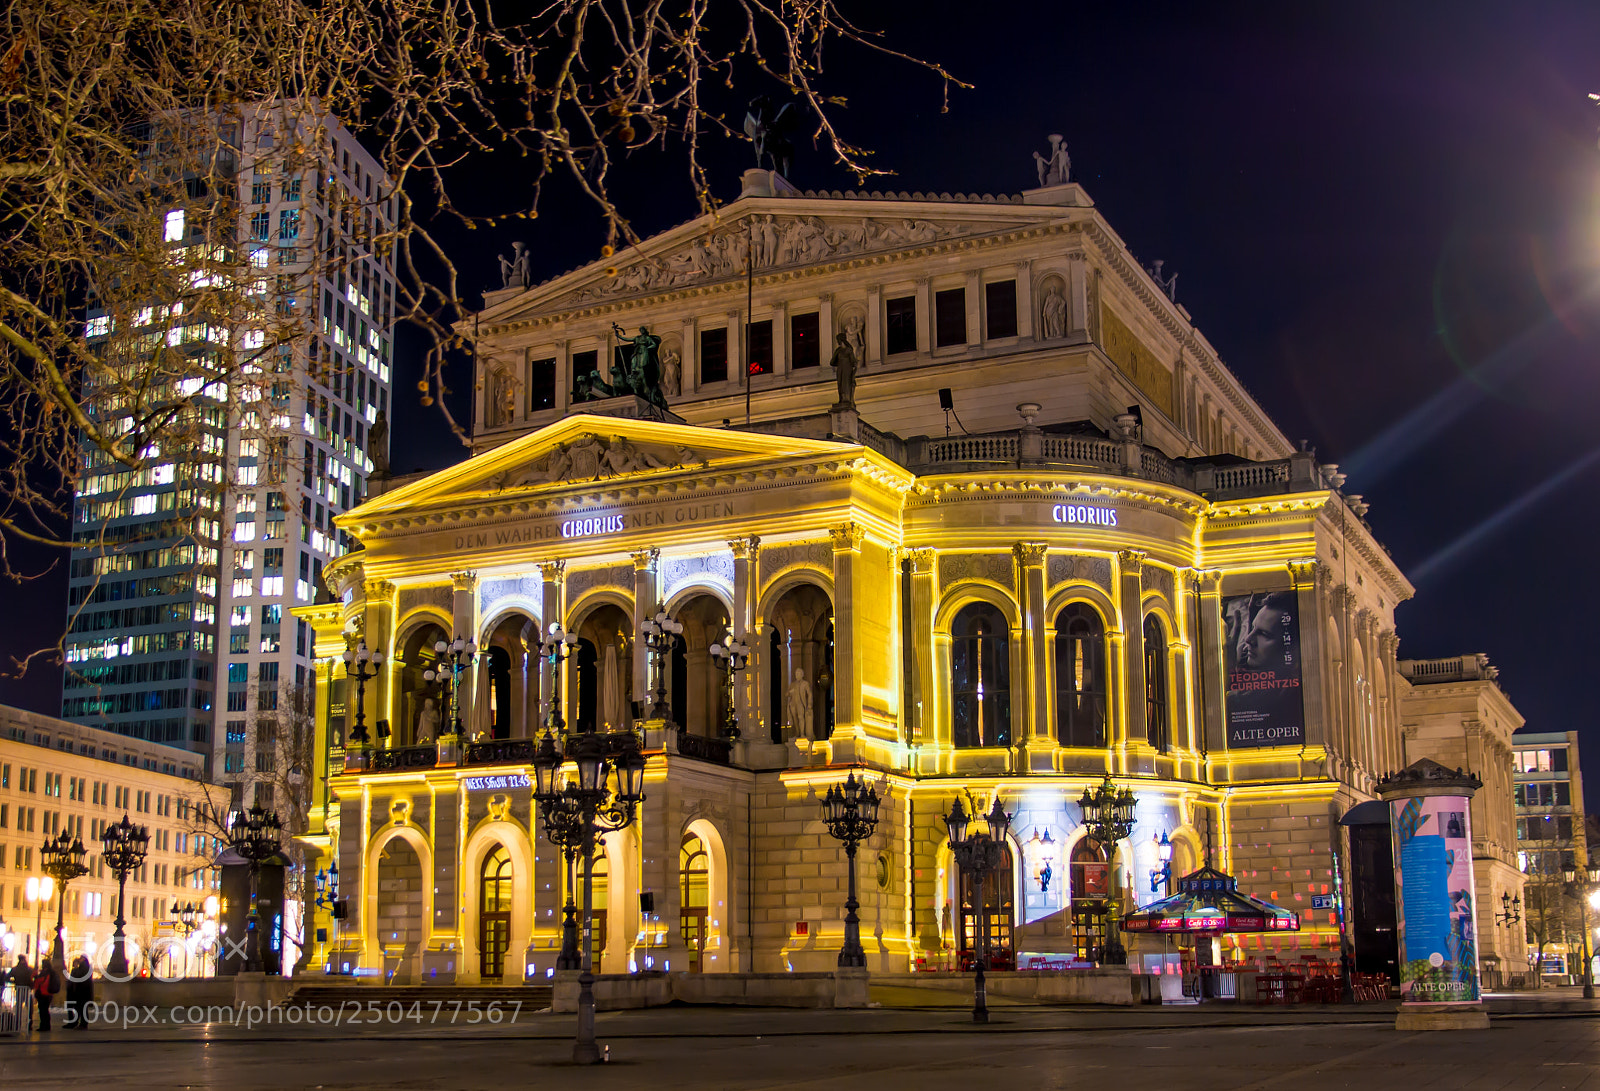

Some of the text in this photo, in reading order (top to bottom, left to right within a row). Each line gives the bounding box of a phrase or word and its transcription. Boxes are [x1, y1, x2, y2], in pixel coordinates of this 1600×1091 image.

[1052, 504, 1118, 527] CIBORIUS
[562, 514, 625, 539] CIBORIUS
[455, 533, 488, 550] DEM
[1282, 634, 1292, 642] 14
[1284, 654, 1293, 662] 15
[1229, 671, 1276, 683] TEODOR
[1230, 679, 1300, 692] CURRENTZIS
[1233, 726, 1300, 741] ALTE OPER
[466, 777, 485, 790] NEXT
[1412, 981, 1465, 992] ALTE OPER
